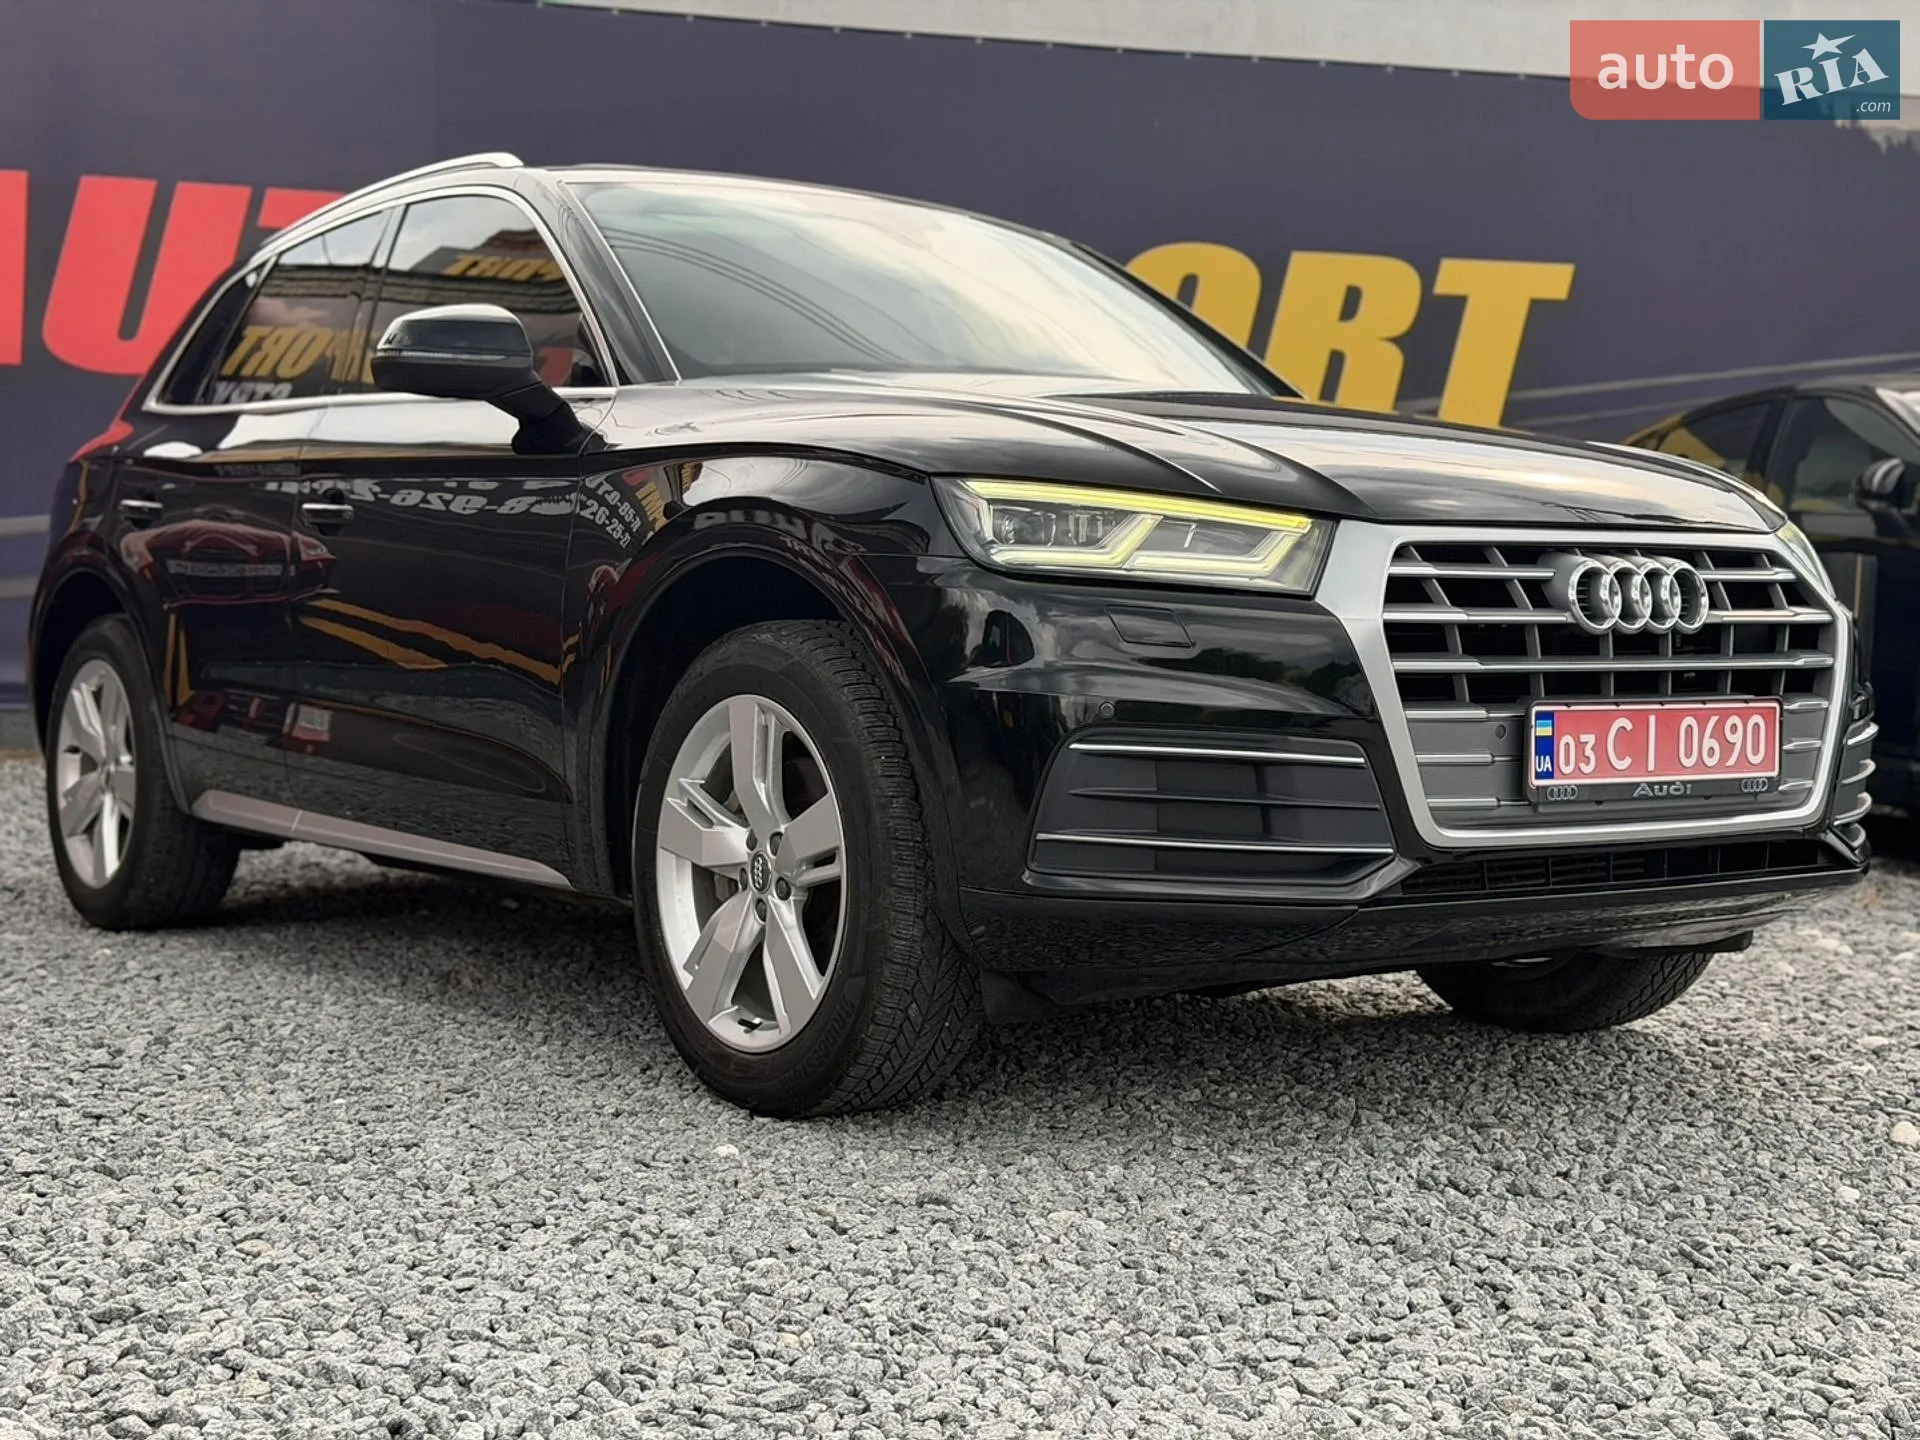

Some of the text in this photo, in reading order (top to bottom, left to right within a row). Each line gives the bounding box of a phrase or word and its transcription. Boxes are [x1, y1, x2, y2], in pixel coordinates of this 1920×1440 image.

[1536, 755, 1553, 773] UA
[1559, 734, 1597, 775] 03
[1678, 714, 1767, 768] 0690
[1632, 780, 1693, 798] Audi
